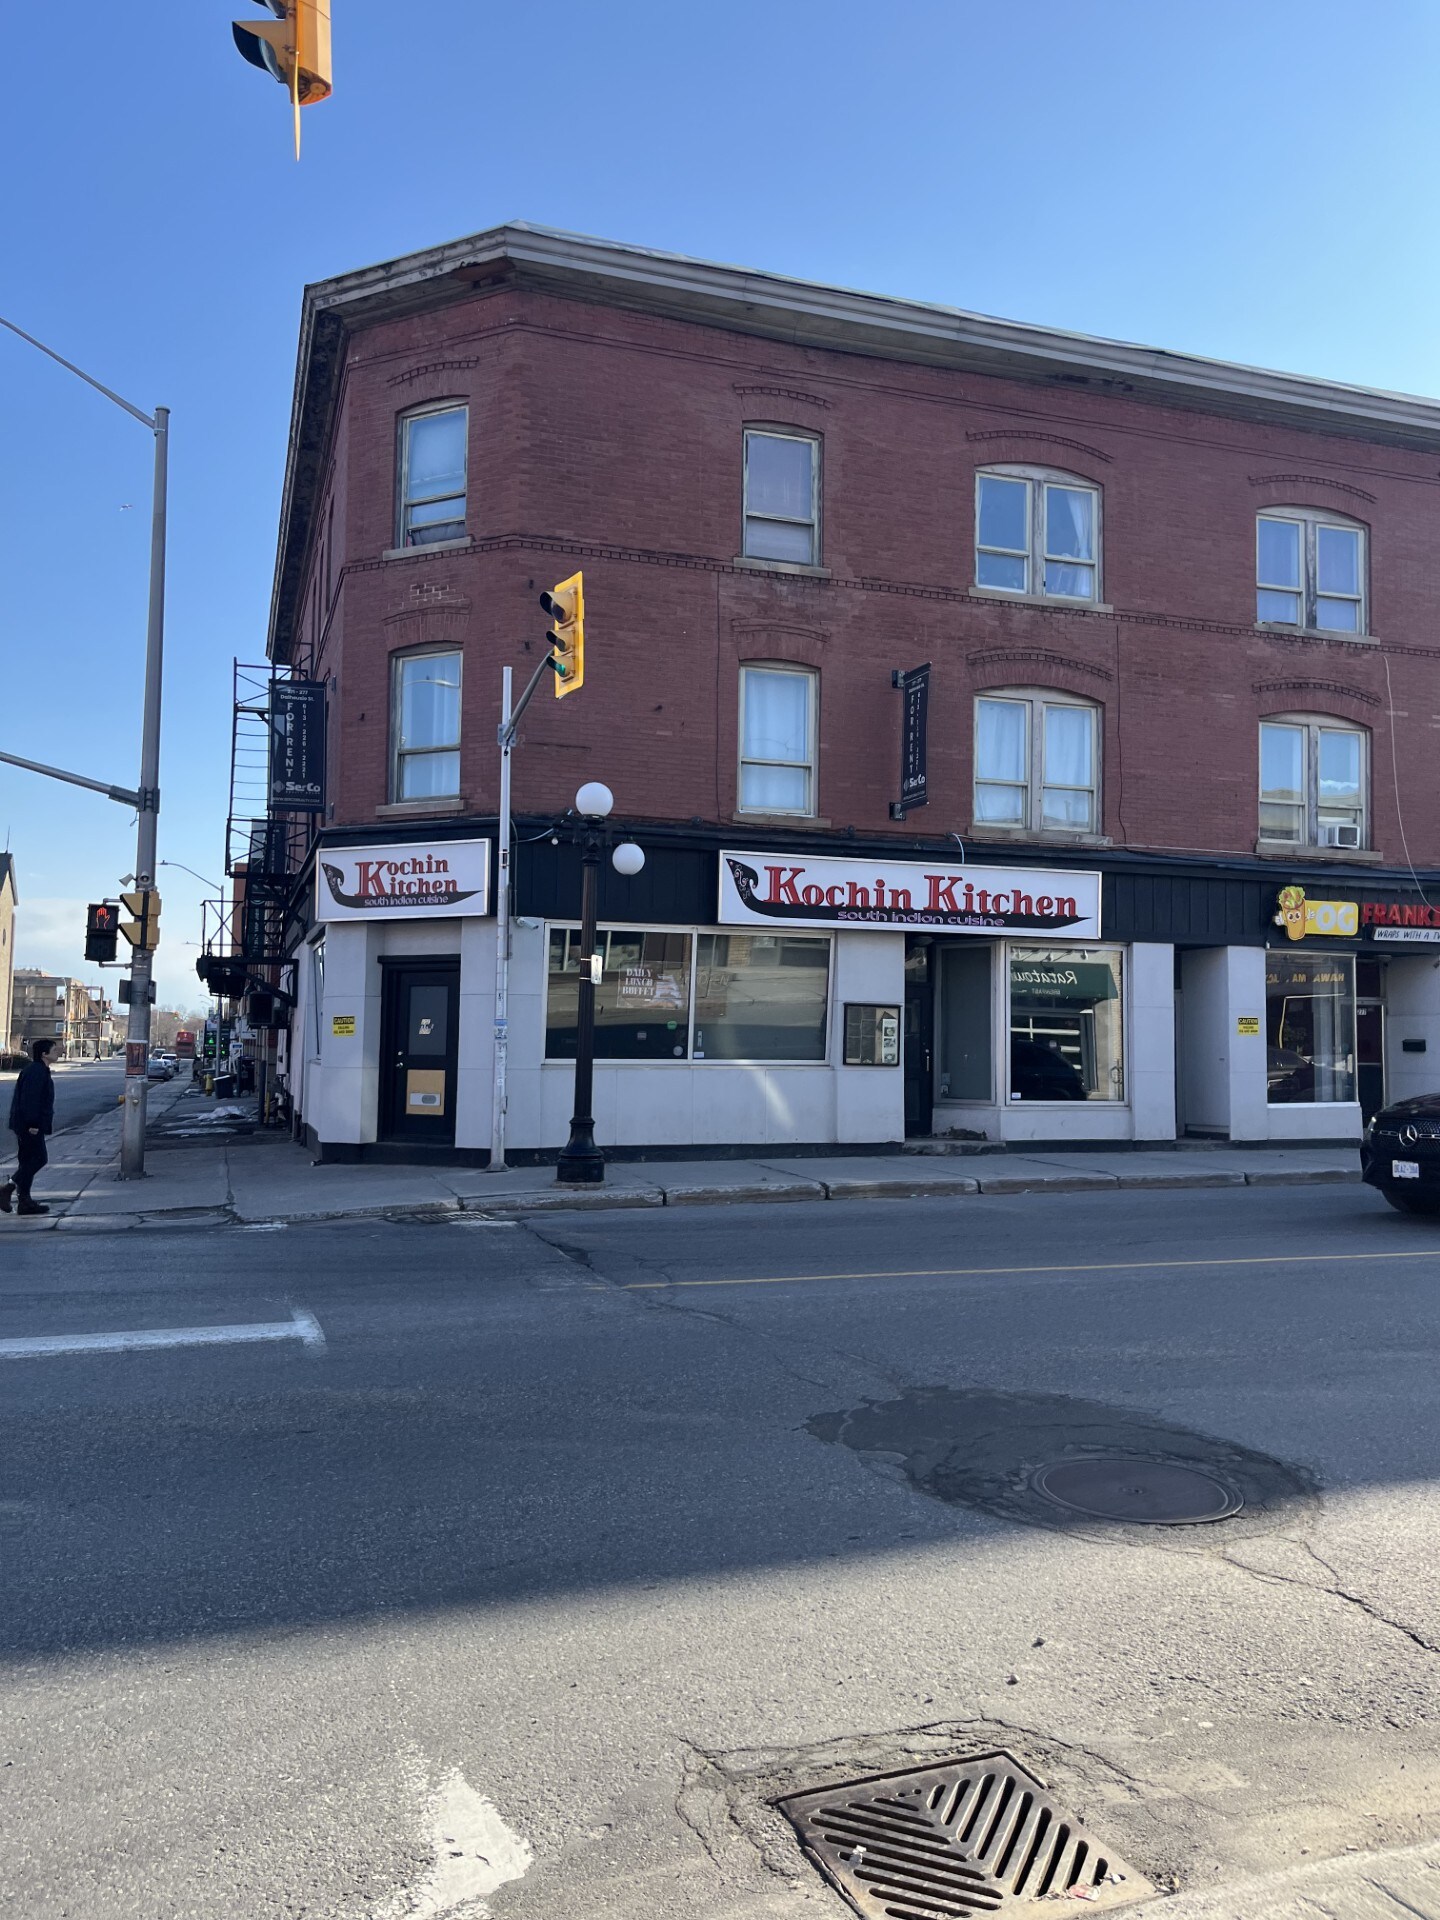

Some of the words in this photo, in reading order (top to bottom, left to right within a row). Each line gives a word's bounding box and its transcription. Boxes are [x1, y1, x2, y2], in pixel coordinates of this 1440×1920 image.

[286, 702, 294, 731] FOR
[286, 737, 294, 777] RENT
[286, 781, 320, 792] SerCo
[764, 866, 912, 909] Kochin
[923, 874, 1079, 917] Kitchen
[364, 897, 389, 907] south
[390, 896, 417, 906] indian
[418, 894, 449, 904] cuisine
[837, 910, 888, 922] south
[891, 911, 943, 924] indian
[947, 914, 1005, 926] cuisine
[1316, 904, 1355, 932] OG
[1377, 929, 1400, 938] WRAPS
[1403, 930, 1421, 939] WITH
[626, 967, 653, 977] DAILY
[625, 977, 653, 986] LUNCH
[622, 986, 655, 996] BUFFET
